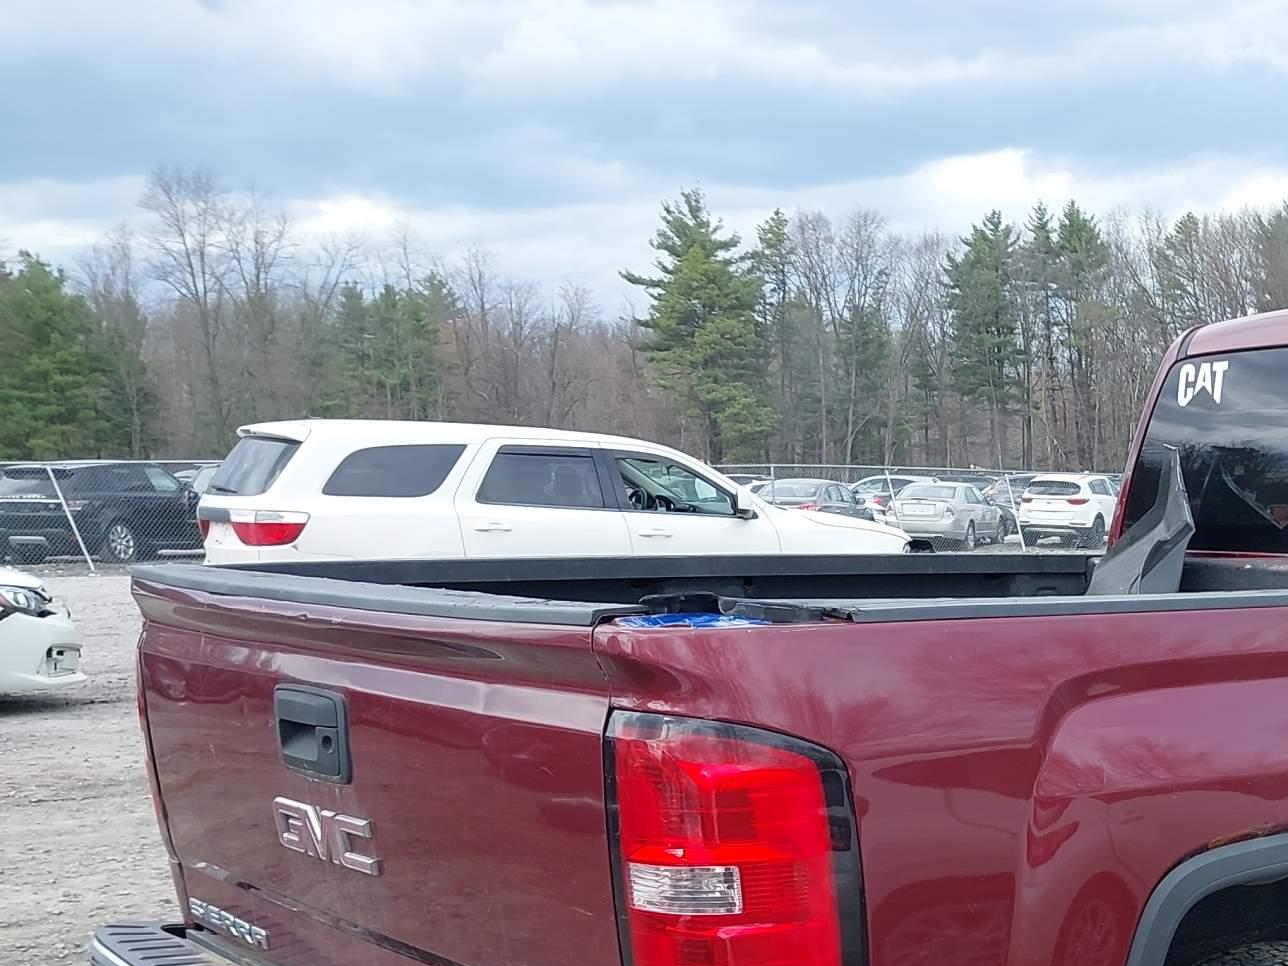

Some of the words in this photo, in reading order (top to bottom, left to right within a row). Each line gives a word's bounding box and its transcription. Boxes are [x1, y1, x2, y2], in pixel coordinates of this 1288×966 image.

[1177, 360, 1229, 407] CAT
[272, 796, 381, 876] GMC
[189, 897, 269, 951] SIERRA
